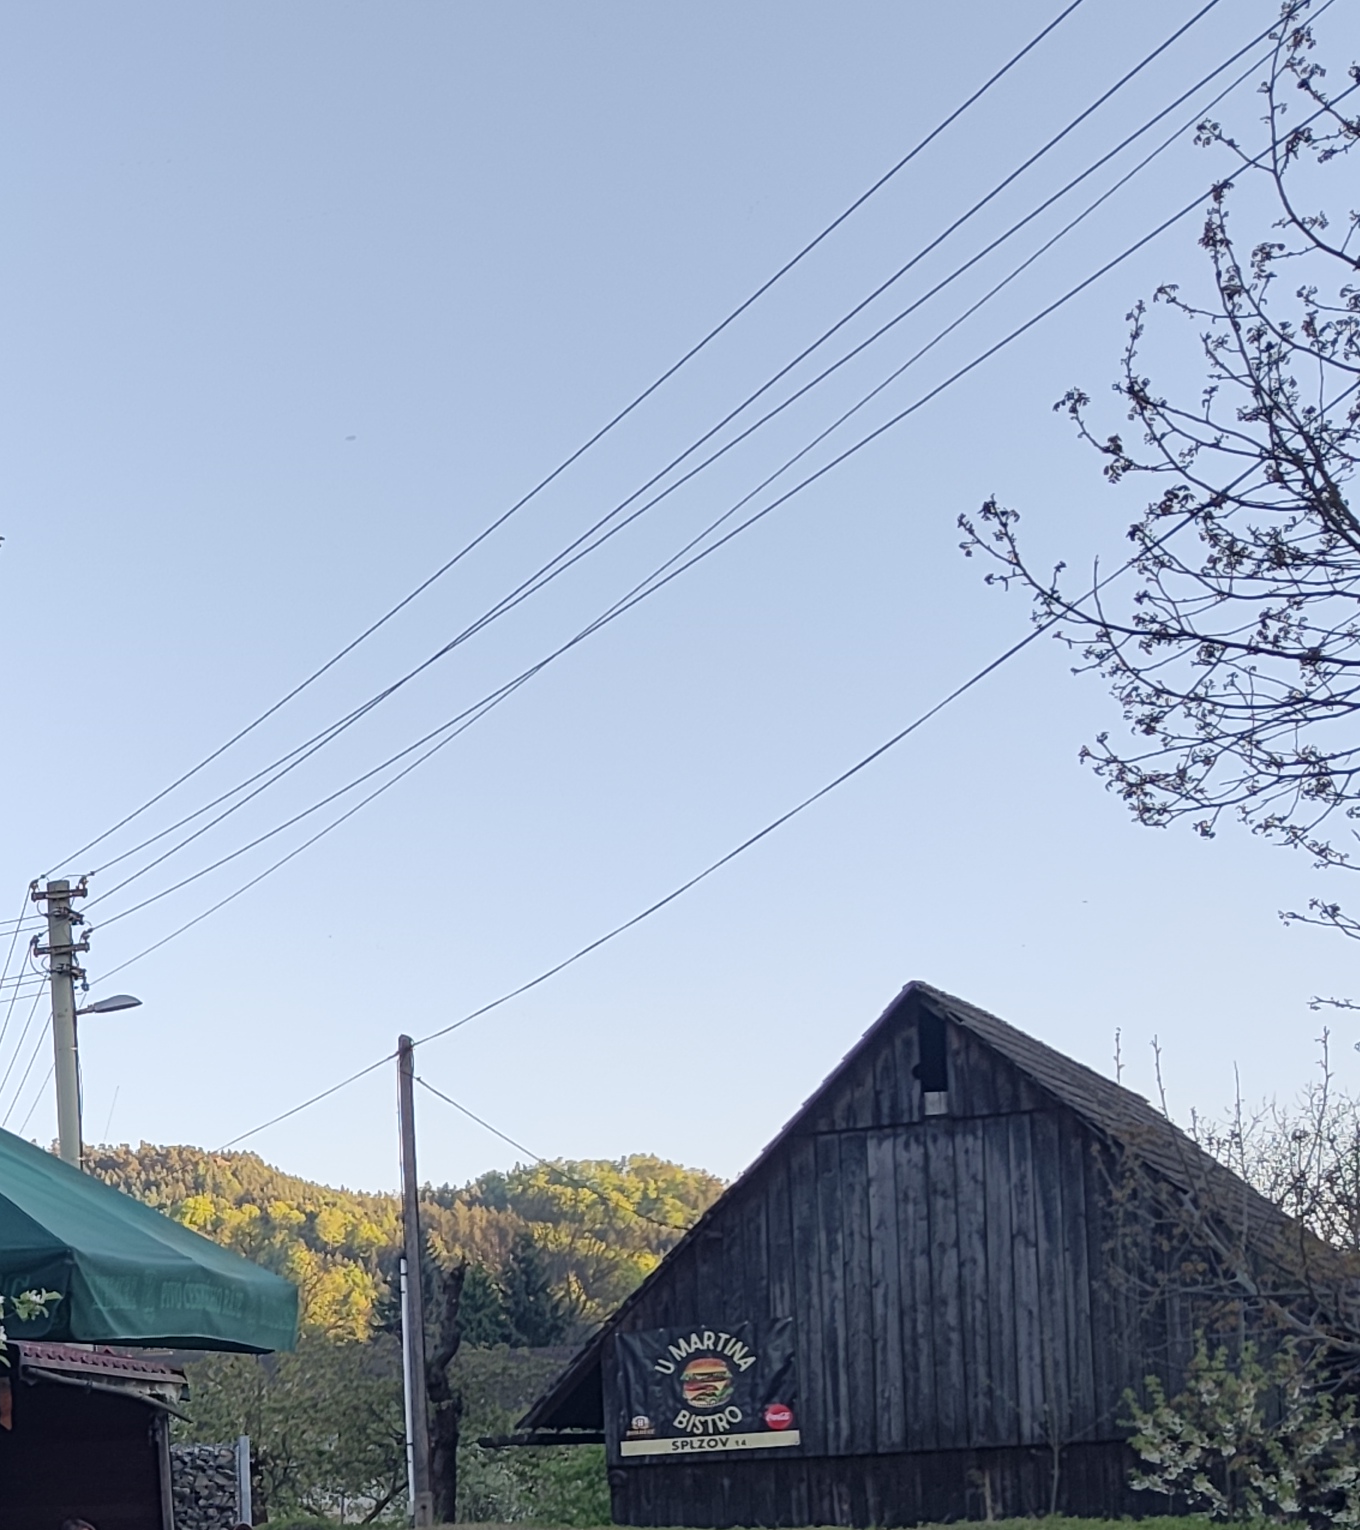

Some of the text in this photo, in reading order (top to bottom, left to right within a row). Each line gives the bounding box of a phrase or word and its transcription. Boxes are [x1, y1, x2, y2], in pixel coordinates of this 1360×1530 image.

[654, 1330, 757, 1375] U MARTINA
[673, 1405, 742, 1434] BISTRO
[671, 1437, 730, 1451] SPLZOV
